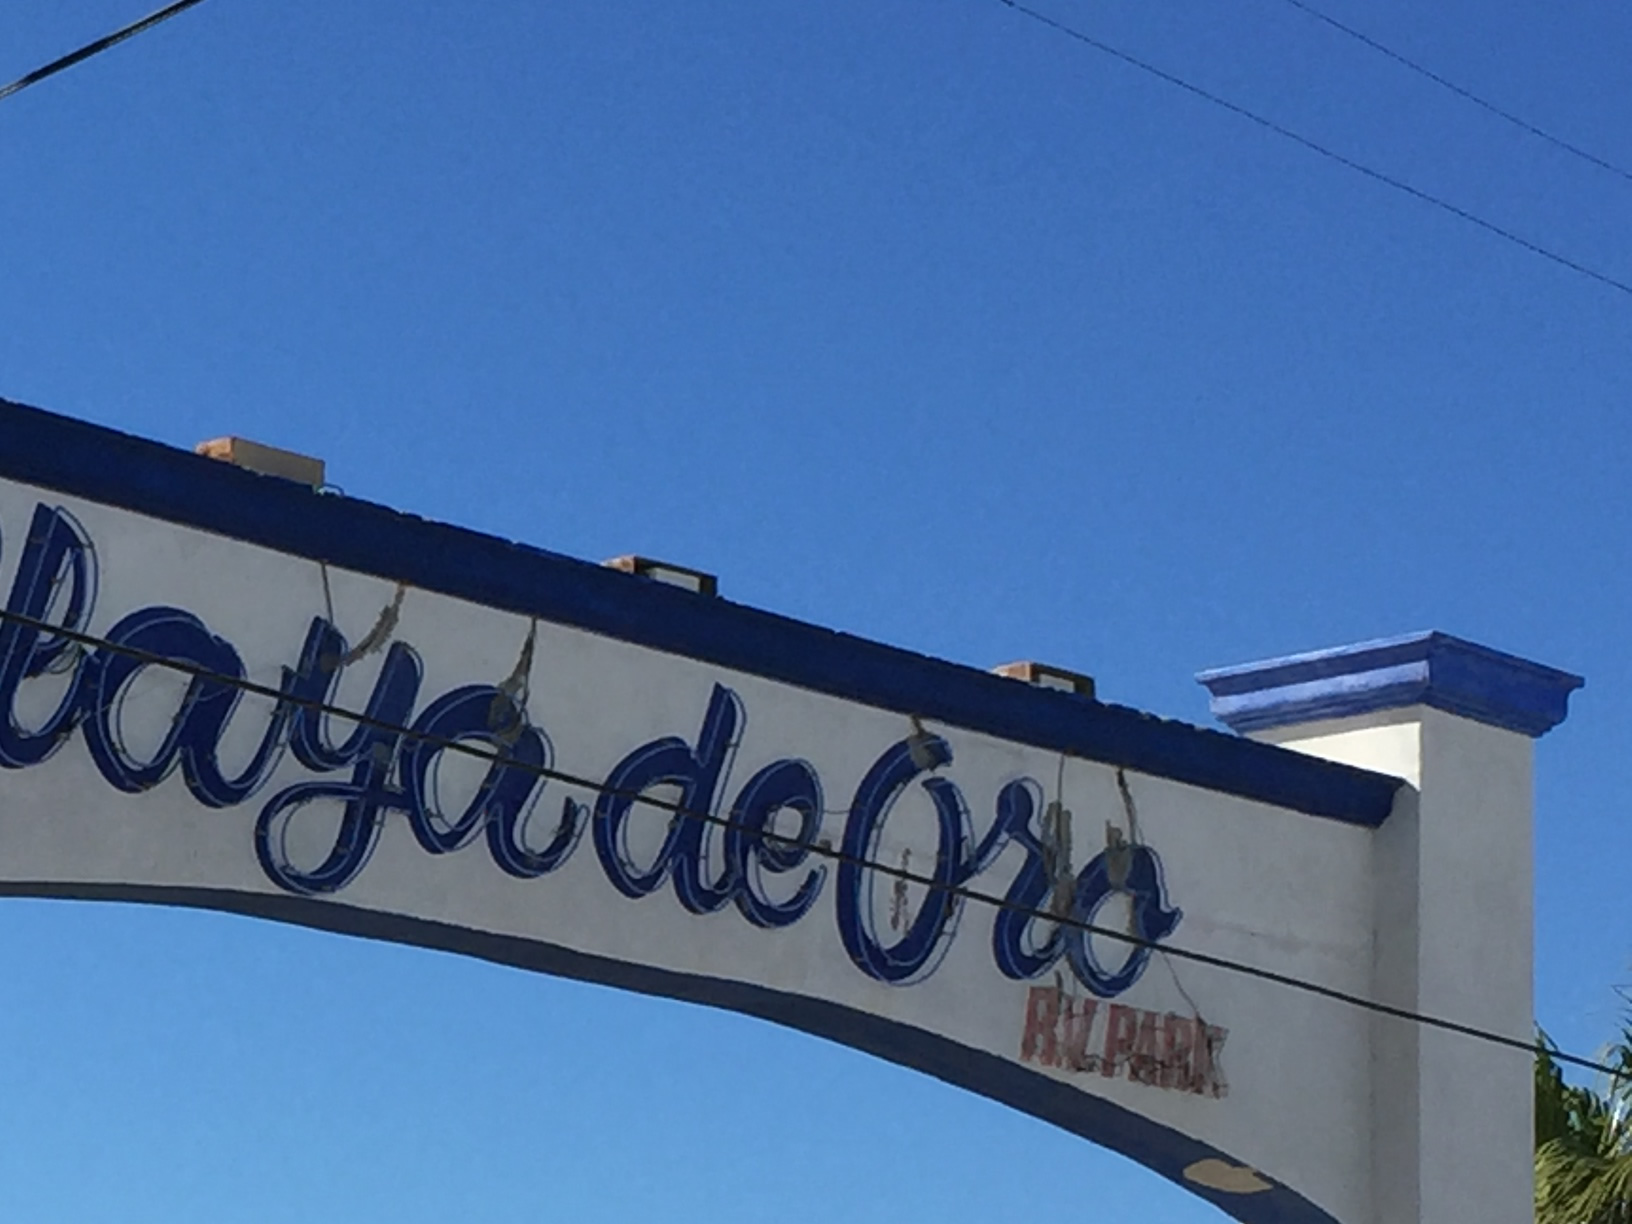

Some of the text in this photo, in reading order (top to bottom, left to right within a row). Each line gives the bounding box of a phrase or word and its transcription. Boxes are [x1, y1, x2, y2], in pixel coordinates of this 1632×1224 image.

[593, 682, 827, 928] de
[836, 730, 1182, 997] Oro
[1100, 1003, 1229, 1099] PARK
